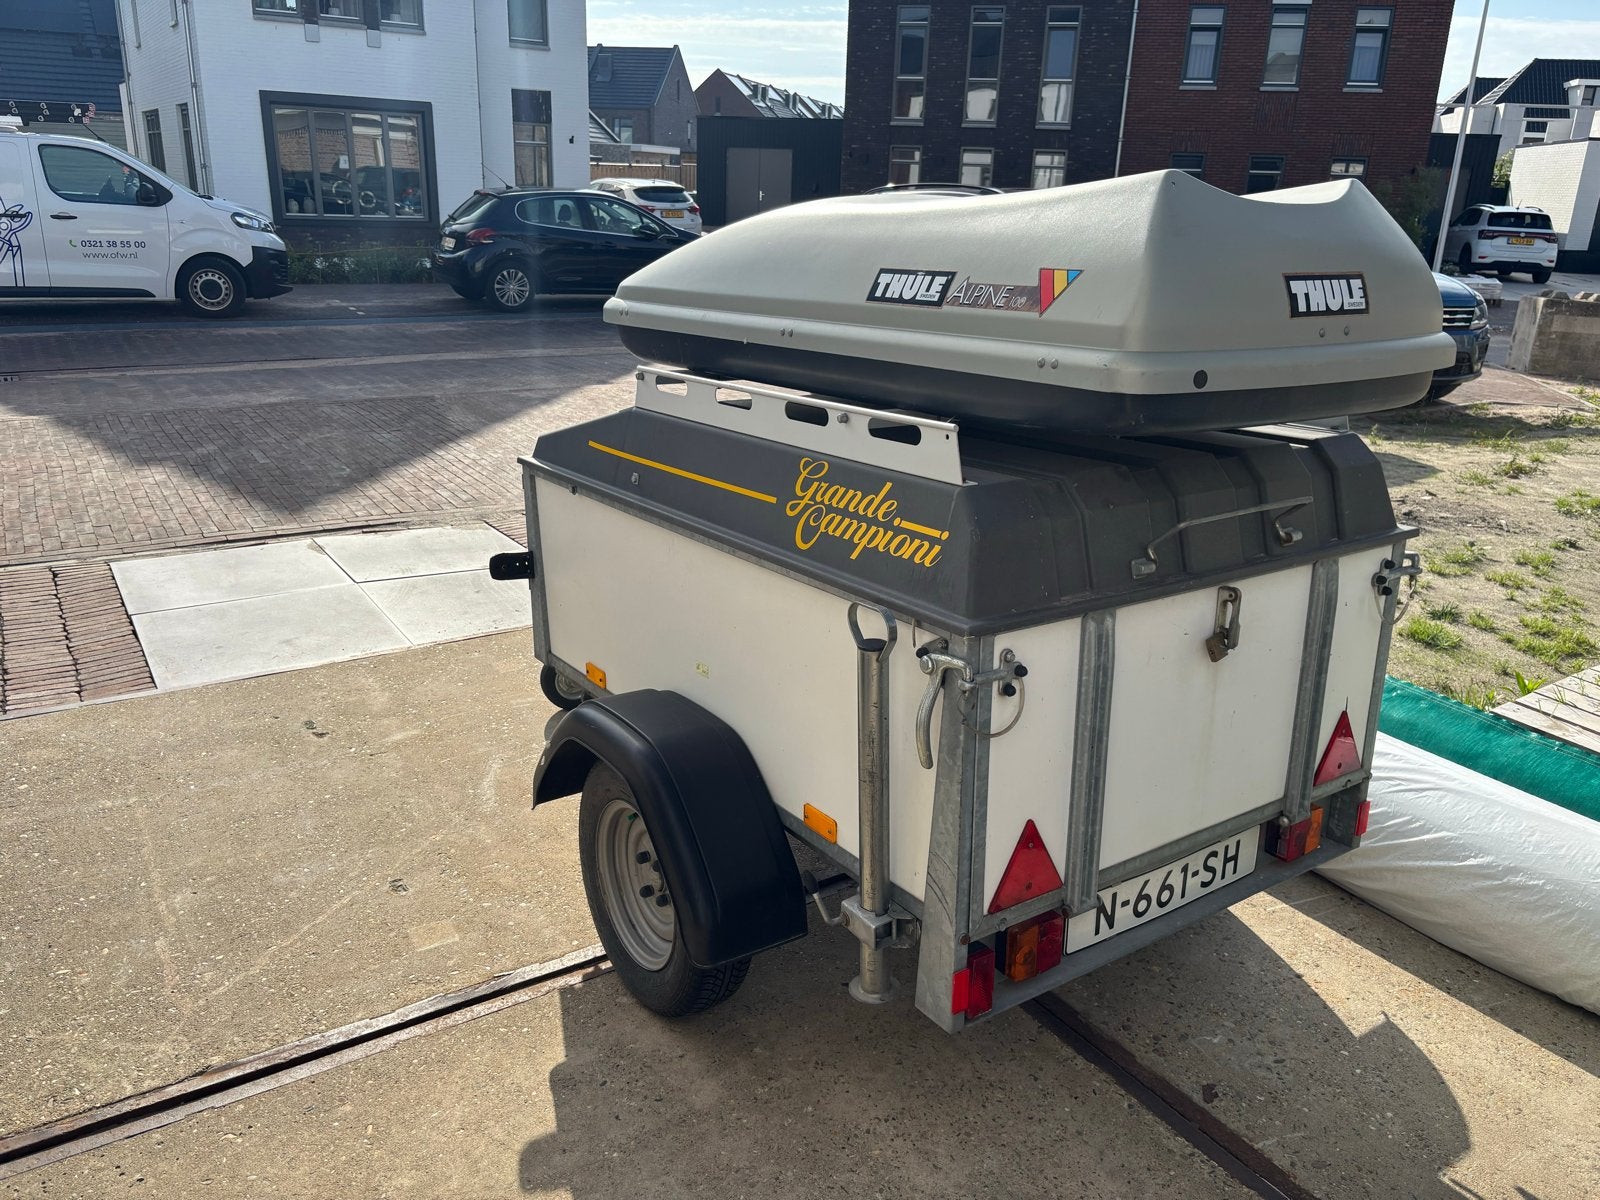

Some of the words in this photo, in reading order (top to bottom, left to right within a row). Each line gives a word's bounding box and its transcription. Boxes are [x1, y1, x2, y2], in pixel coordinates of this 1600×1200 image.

[80, 240, 104, 248] 0321
[105, 240, 118, 248] 38
[120, 240, 132, 248] 55
[134, 241, 146, 249] 00
[82, 251, 138, 259] www.ofw.nl
[874, 271, 948, 302] THULE
[946, 276, 1015, 308] ALPINE
[1289, 278, 1367, 313] THULE
[785, 457, 899, 518] Grande
[795, 504, 944, 568] Campioni
[1094, 839, 1242, 937] N-661-SH
